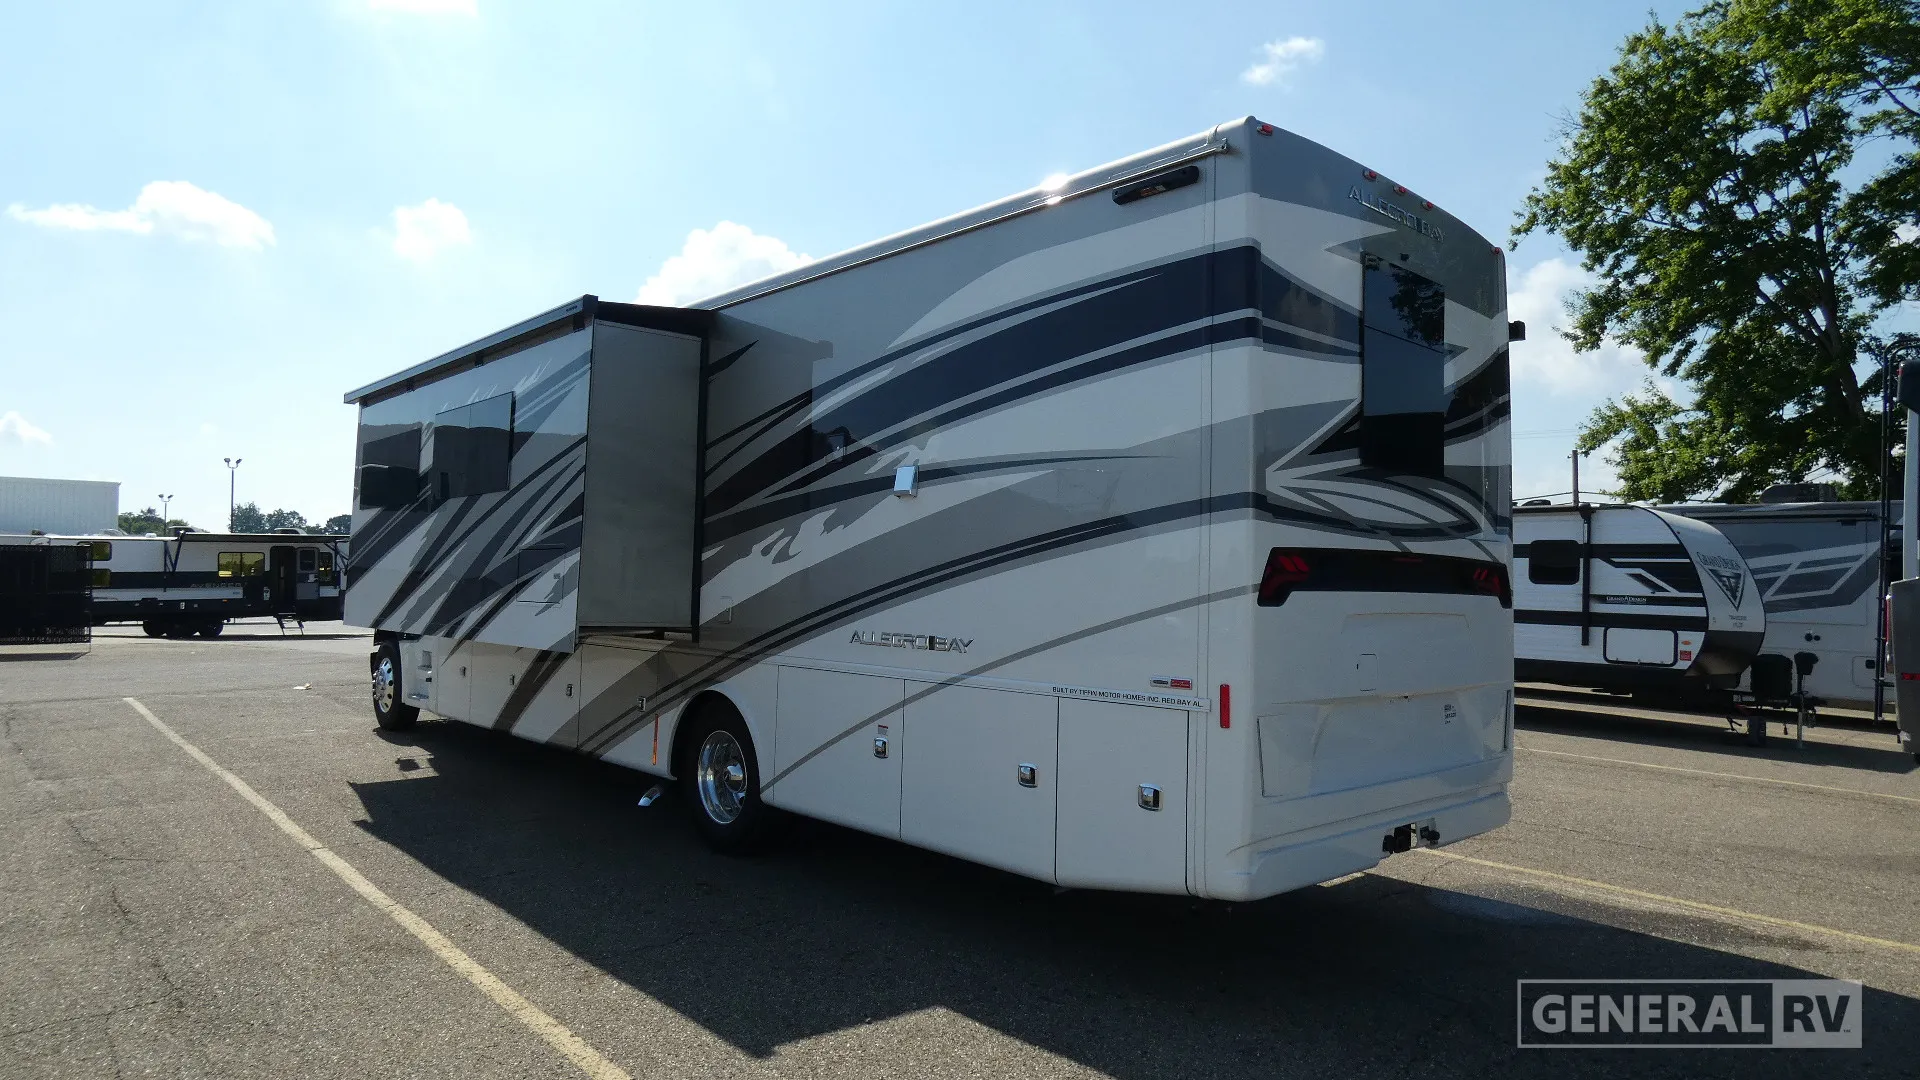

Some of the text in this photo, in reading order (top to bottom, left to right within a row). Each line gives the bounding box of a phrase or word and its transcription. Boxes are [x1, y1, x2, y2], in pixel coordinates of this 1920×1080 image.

[1348, 185, 1446, 241] ALLEGRO BAY
[849, 630, 974, 654] ALLEGRO BAY
[1052, 686, 1069, 694] BUILT
[1079, 689, 1098, 697] TIFFIN
[1098, 691, 1121, 699] MOTOR
[1122, 693, 1146, 701] HOMES
[1161, 697, 1176, 705] RED
